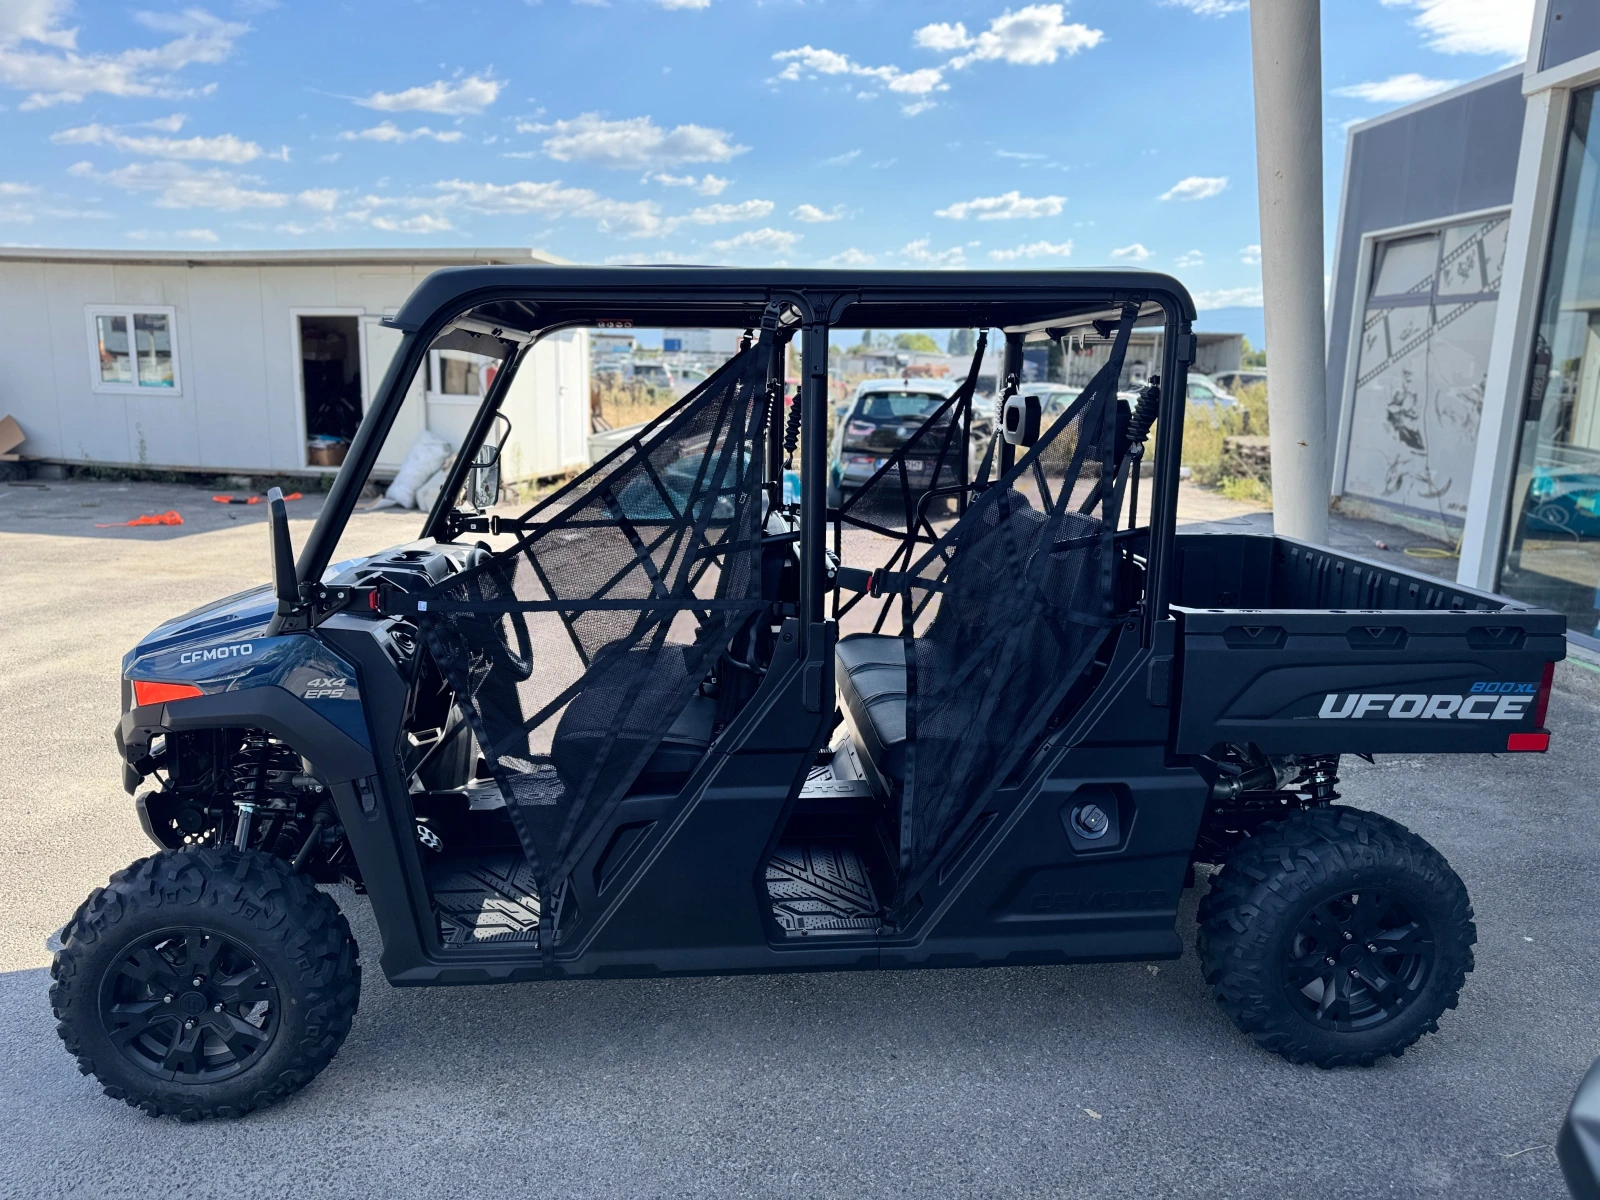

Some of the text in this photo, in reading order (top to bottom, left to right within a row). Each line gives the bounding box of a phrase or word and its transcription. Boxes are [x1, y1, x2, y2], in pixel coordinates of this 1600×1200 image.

[181, 644, 253, 664] CFMOTO
[304, 689, 345, 698] EPS
[1318, 694, 1534, 719] UFORCE
